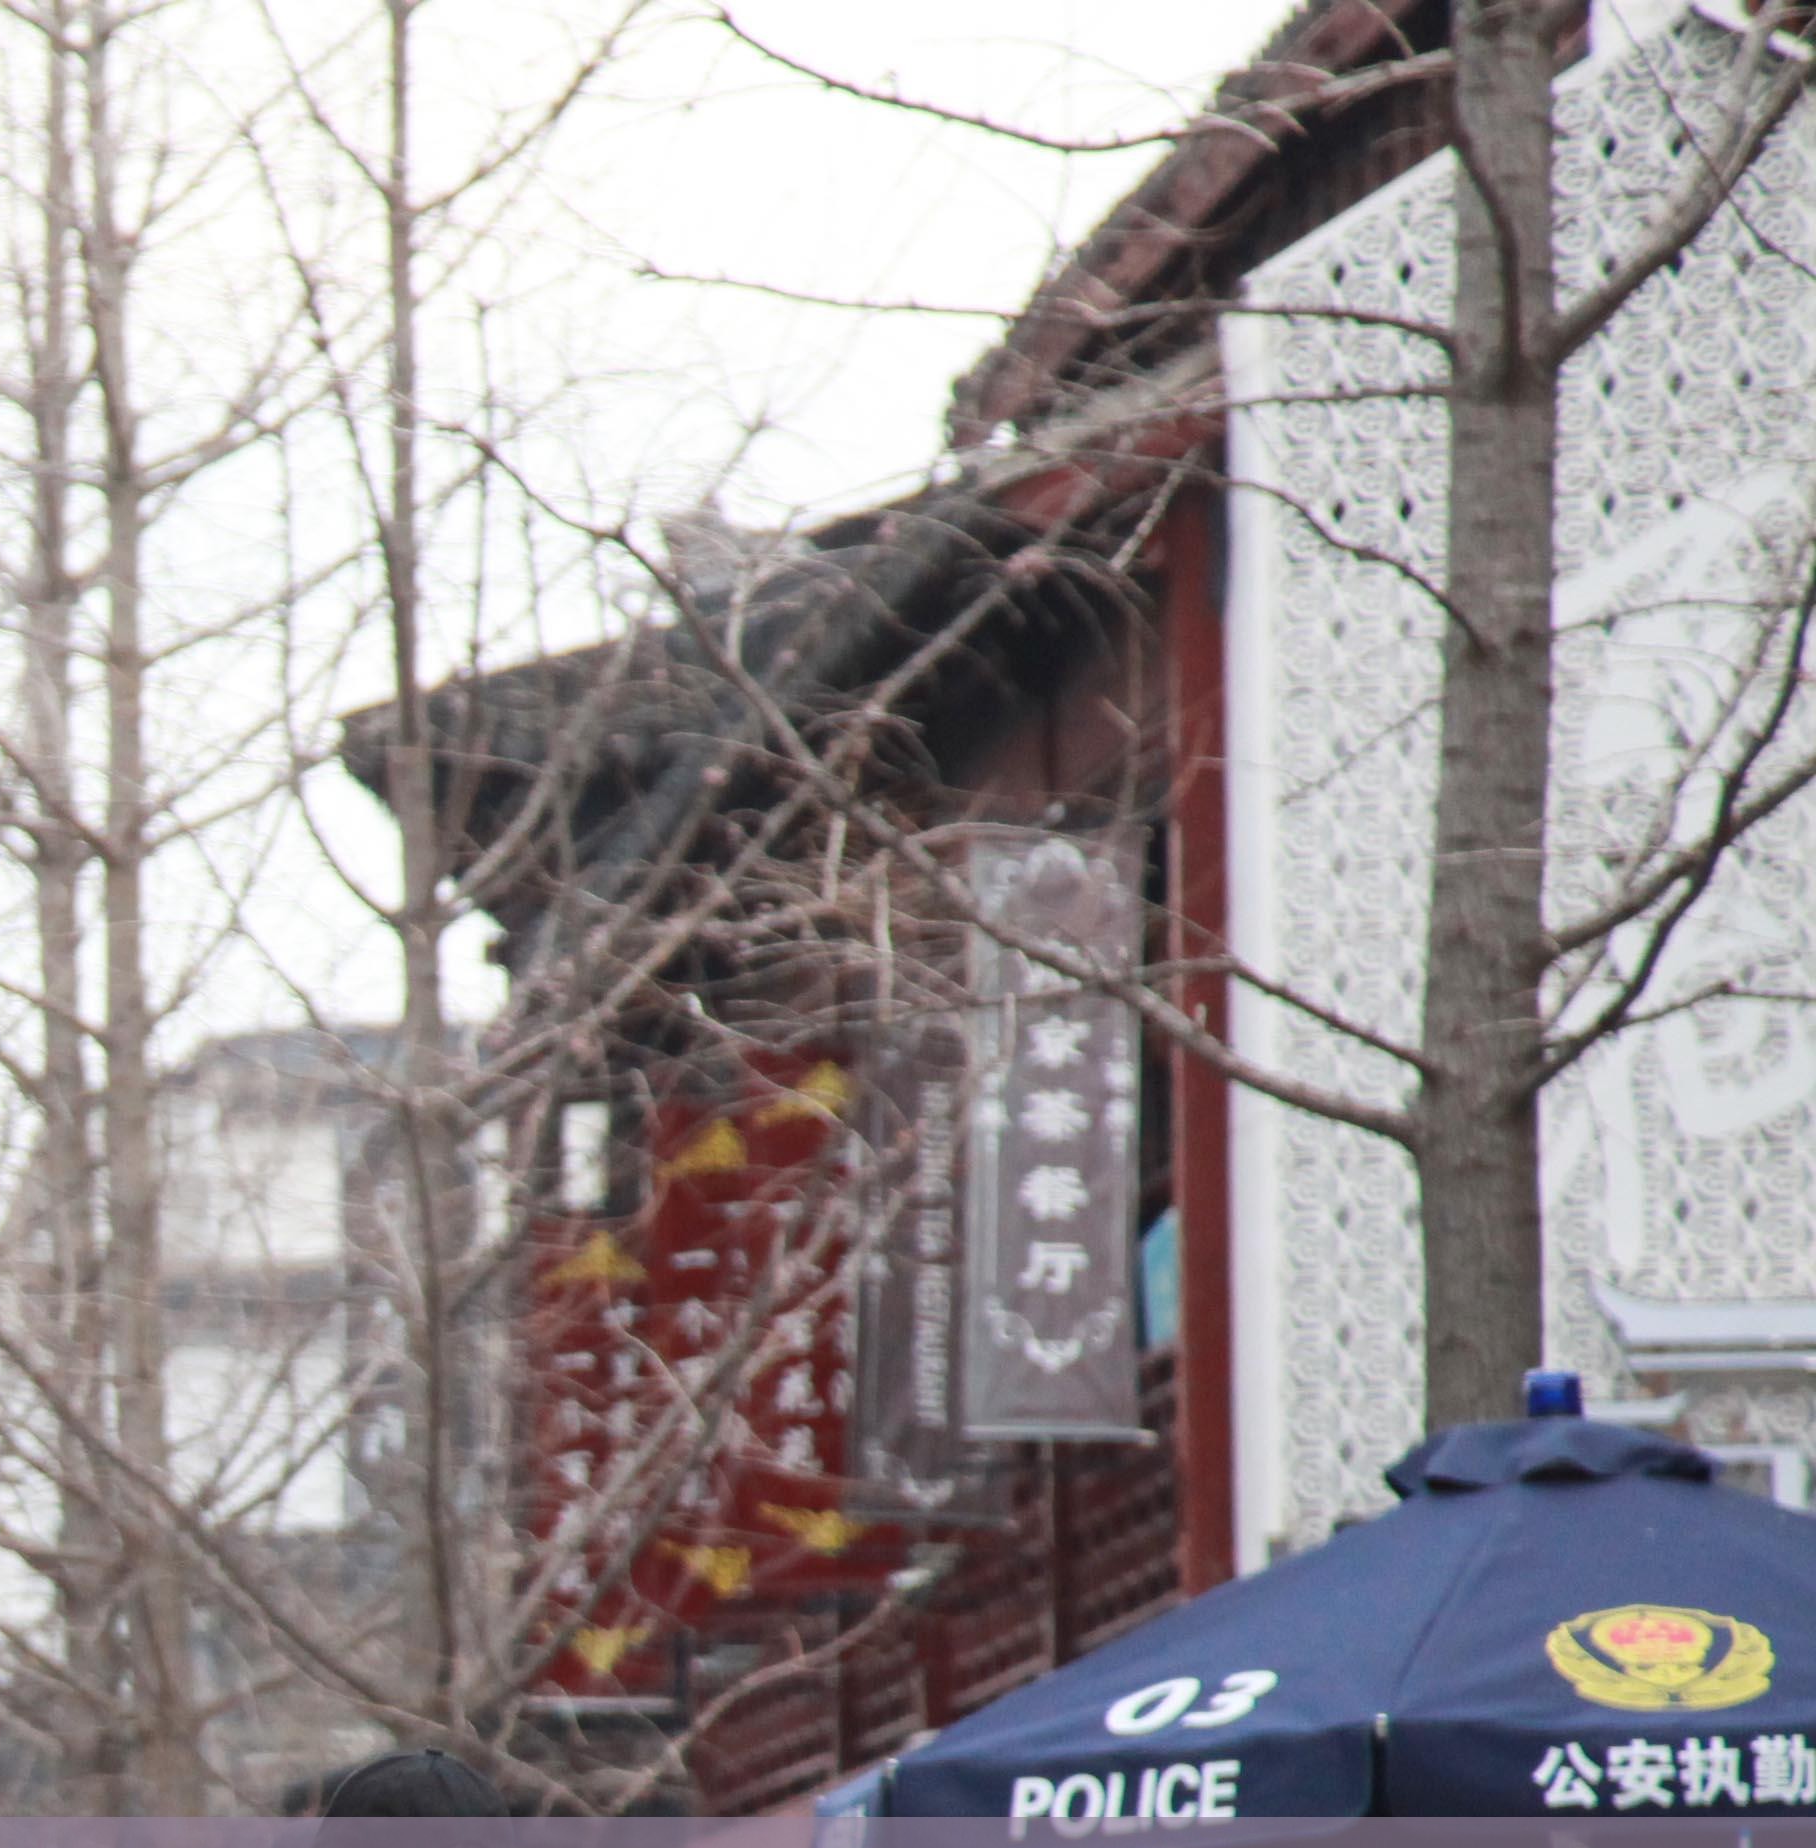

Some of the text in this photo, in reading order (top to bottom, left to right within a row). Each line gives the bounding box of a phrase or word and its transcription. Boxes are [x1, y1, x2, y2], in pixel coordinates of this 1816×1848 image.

[1104, 1668, 1279, 1736] 03
[1008, 1758, 1242, 1842] POLICE
[1531, 1734, 1816, 1810] 公安执勤
